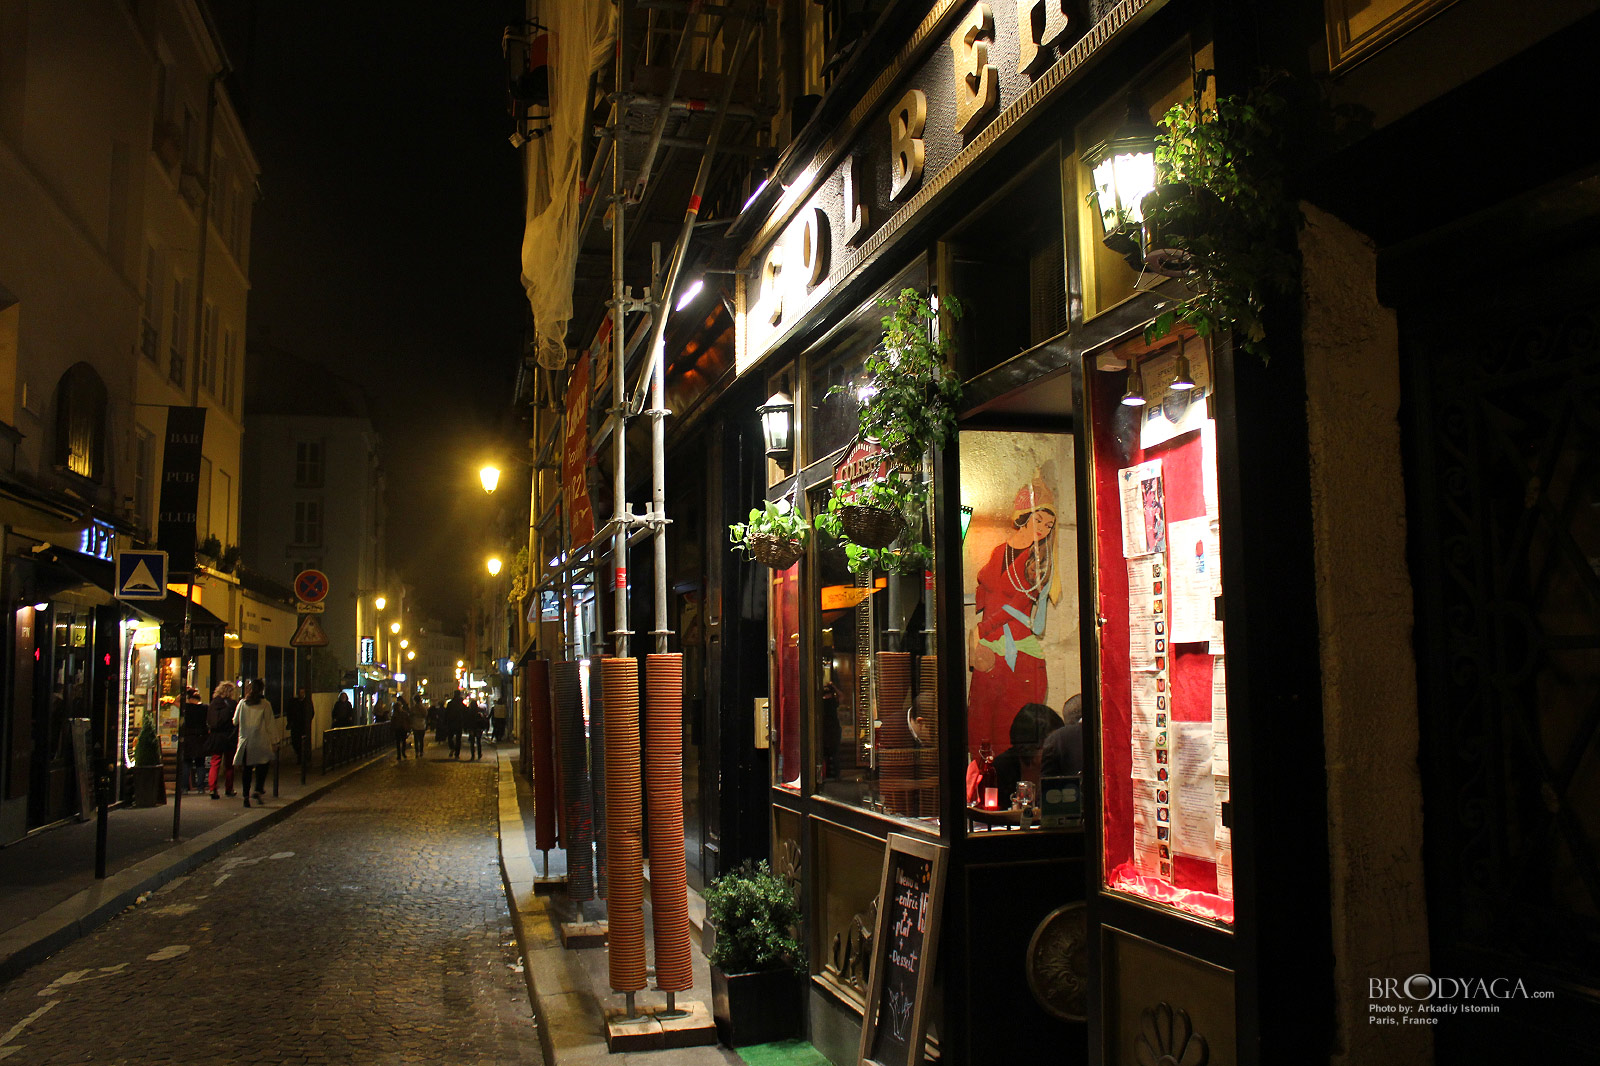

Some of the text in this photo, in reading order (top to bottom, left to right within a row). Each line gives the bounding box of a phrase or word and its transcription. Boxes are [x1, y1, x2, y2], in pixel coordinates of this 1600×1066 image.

[170, 432, 200, 444] BAR
[167, 471, 196, 483] PUB
[160, 511, 197, 523] CLUB
